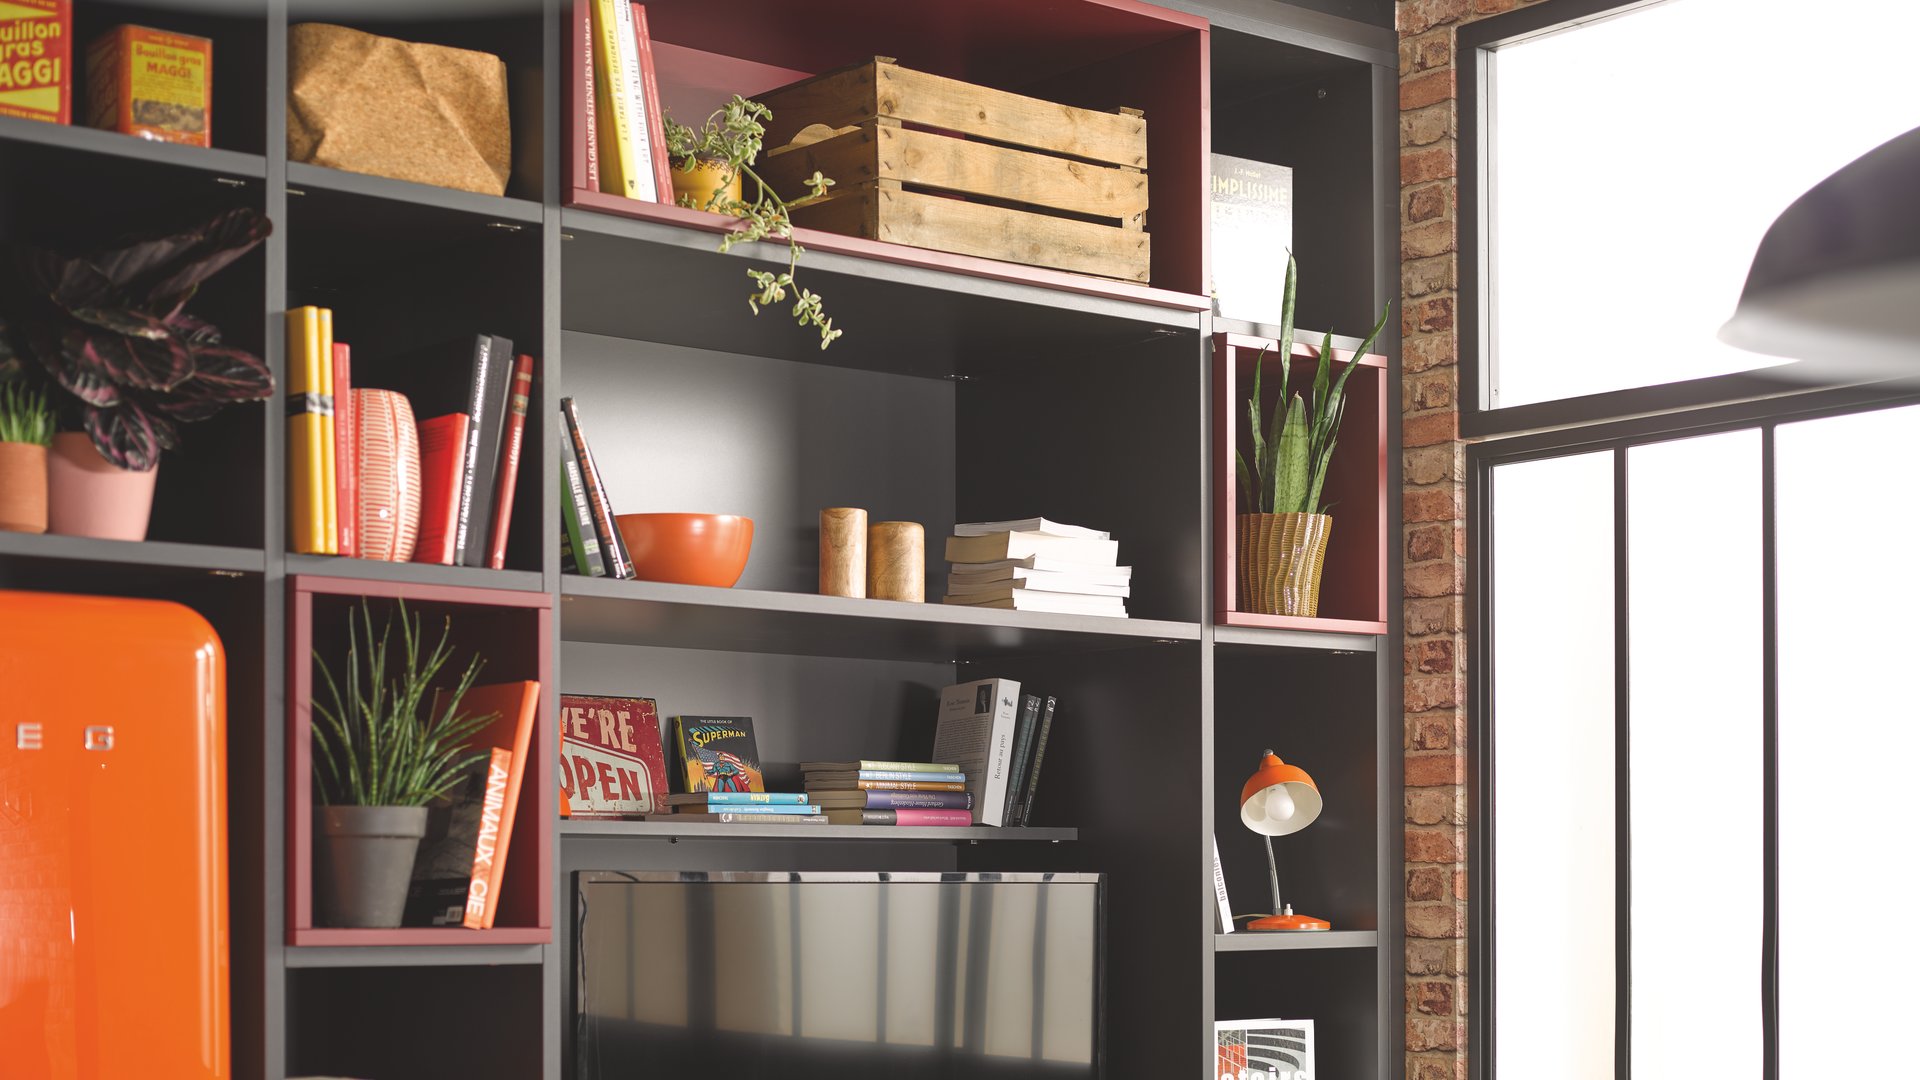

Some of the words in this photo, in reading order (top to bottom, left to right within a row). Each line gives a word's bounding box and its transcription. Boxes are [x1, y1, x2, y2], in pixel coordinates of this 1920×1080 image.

[147, 61, 193, 79] MAGGI
[586, 115, 597, 161] GRANDES
[588, 162, 598, 181] LES
[566, 460, 582, 499] MARSEILLE
[575, 495, 586, 510] SUR
[693, 730, 746, 748] SUPERMAN
[994, 757, 1004, 780] Retour
[900, 782, 917, 790] STYLE
[750, 793, 770, 804] BATMAN
[475, 764, 508, 867] ANIMAUX
[1213, 856, 1226, 902] balconies
[466, 879, 488, 917] CIE
